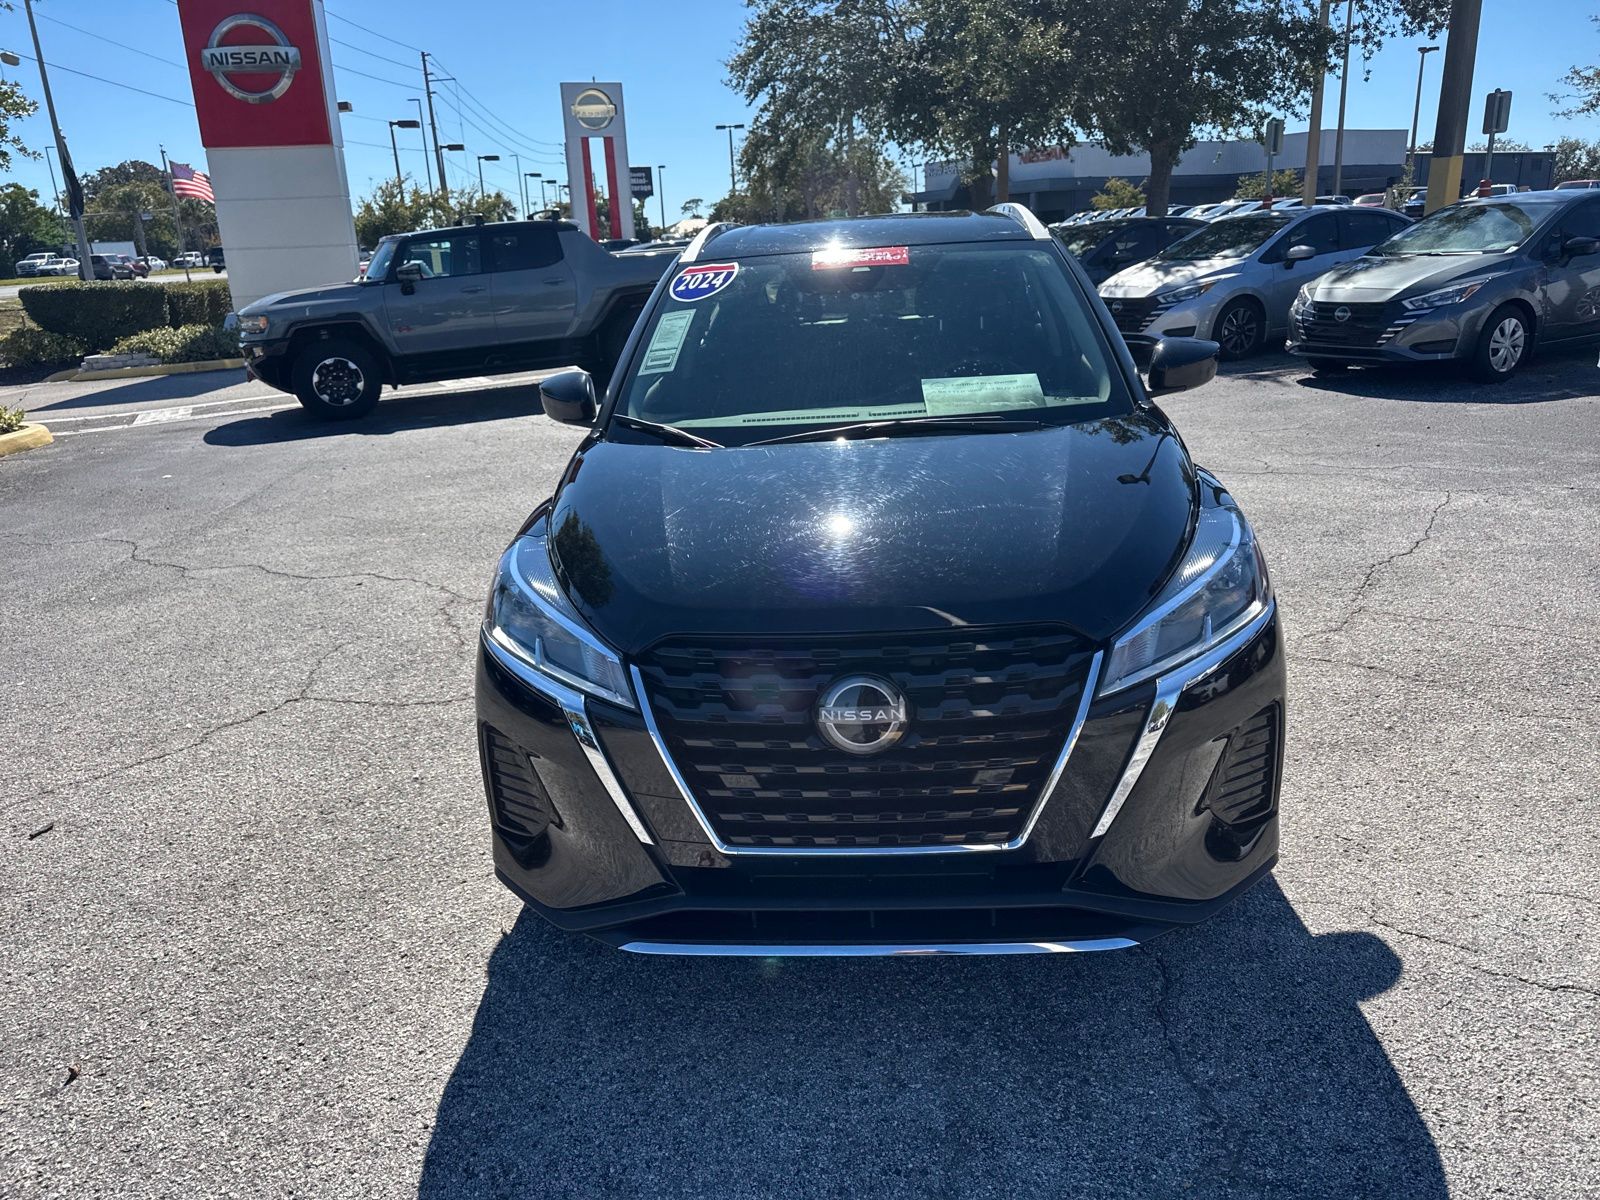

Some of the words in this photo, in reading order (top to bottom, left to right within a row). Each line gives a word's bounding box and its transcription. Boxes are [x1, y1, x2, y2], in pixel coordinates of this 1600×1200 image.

[210, 51, 290, 66] NISSAN
[675, 271, 727, 292] 2024
[821, 708, 904, 721] NISSAN
